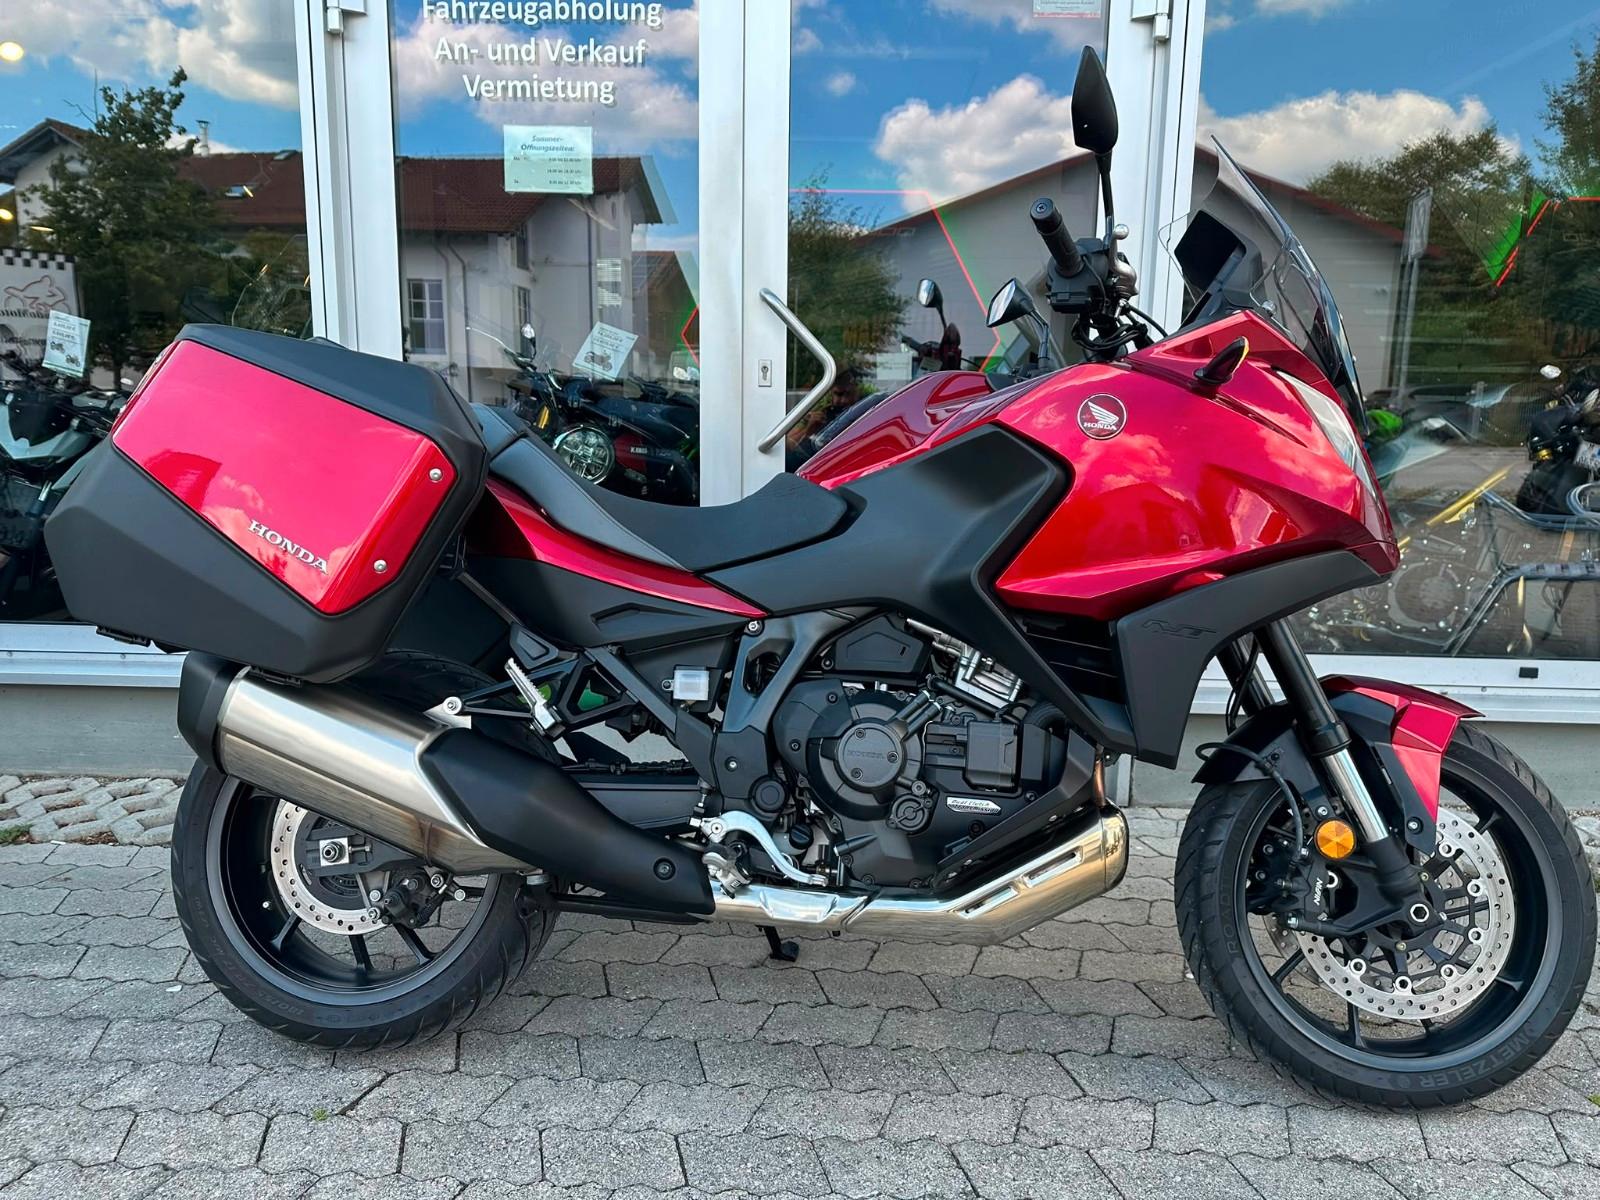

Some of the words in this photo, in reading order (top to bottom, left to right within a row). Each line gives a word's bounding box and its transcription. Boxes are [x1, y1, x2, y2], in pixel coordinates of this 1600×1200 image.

[423, 0, 662, 26] Fahrzeugabholung
[435, 38, 479, 60] An-
[488, 38, 536, 63] und
[544, 38, 647, 64] Verkauf
[463, 73, 615, 104] Vermietung
[1083, 422, 1117, 431] HONDA
[248, 520, 328, 575] HONDA
[1419, 1029, 1530, 1088] METZELER
